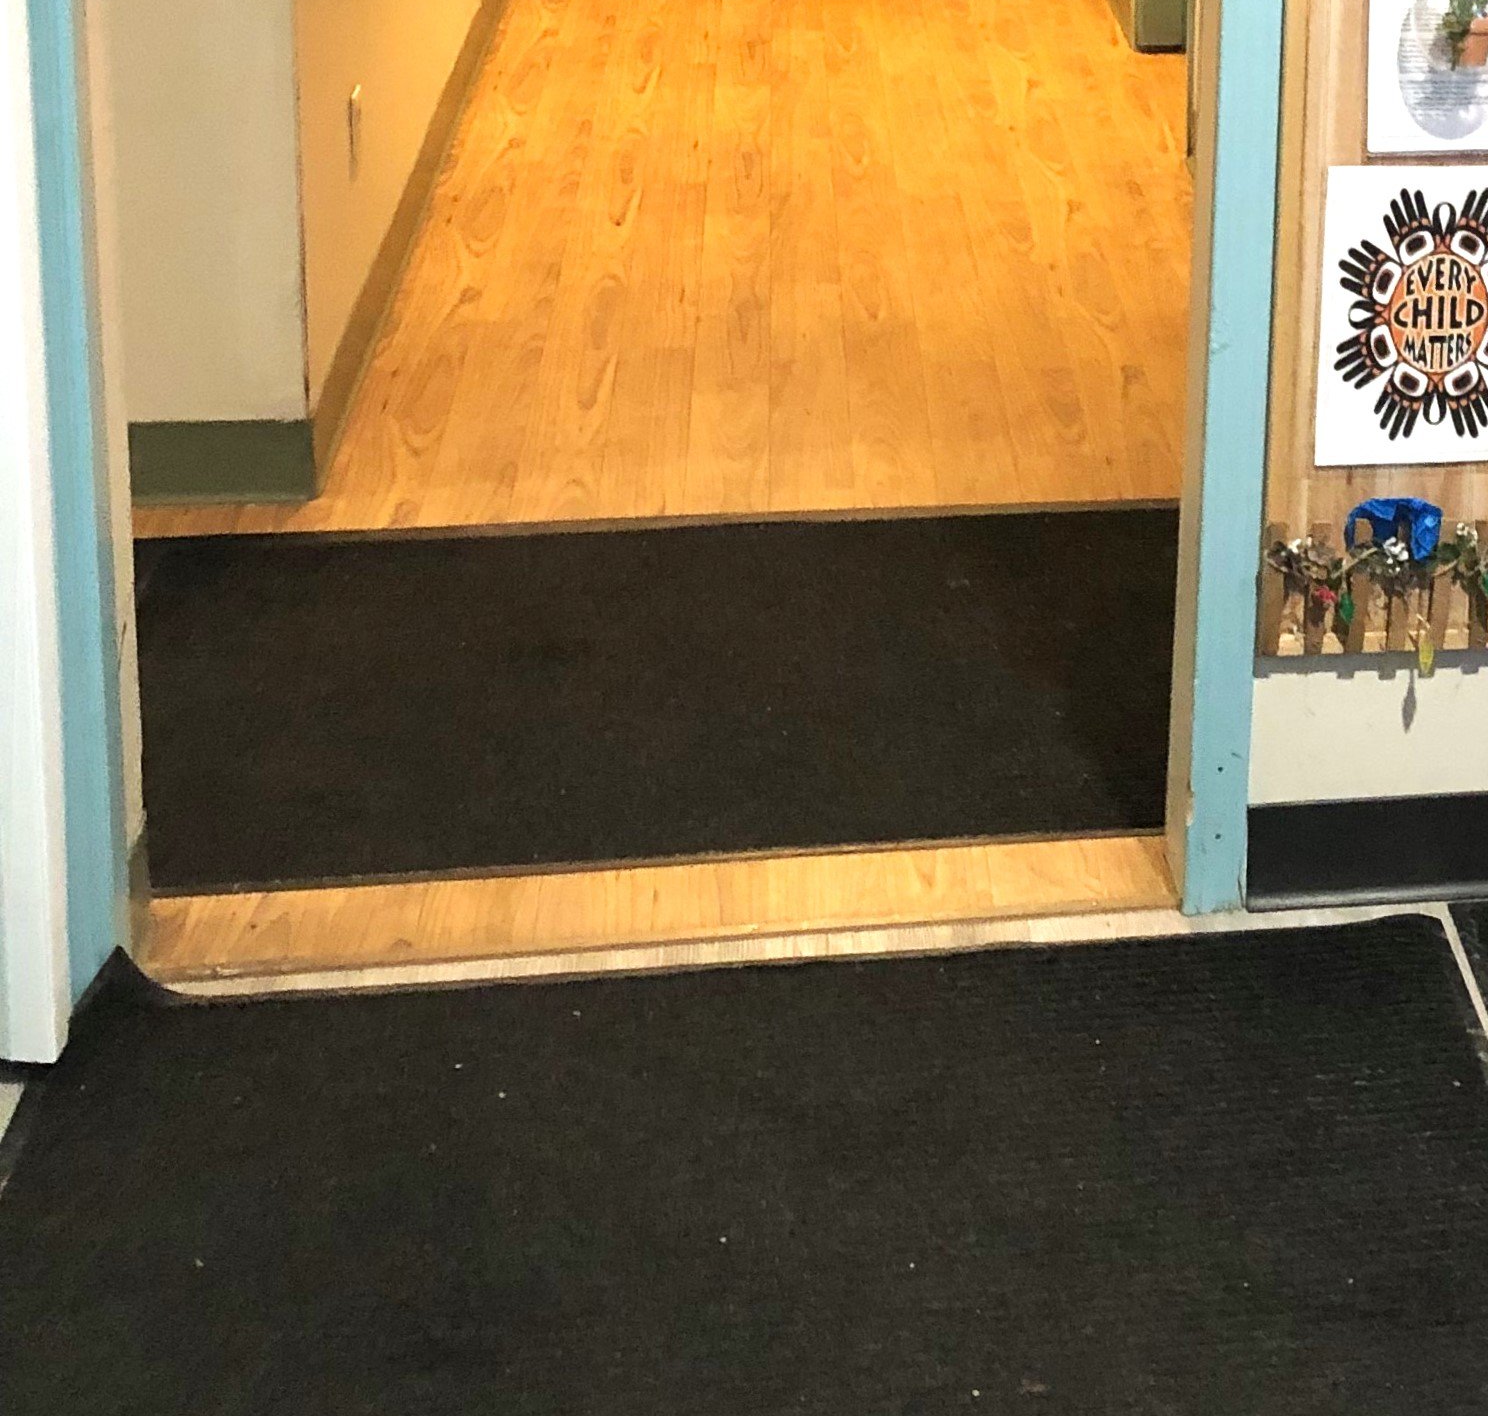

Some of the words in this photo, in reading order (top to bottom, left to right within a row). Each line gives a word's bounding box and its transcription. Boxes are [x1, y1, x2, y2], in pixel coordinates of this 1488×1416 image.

[1406, 257, 1477, 297] EVERY
[1393, 295, 1485, 330] CHILD
[1403, 333, 1473, 369] MATTERS
